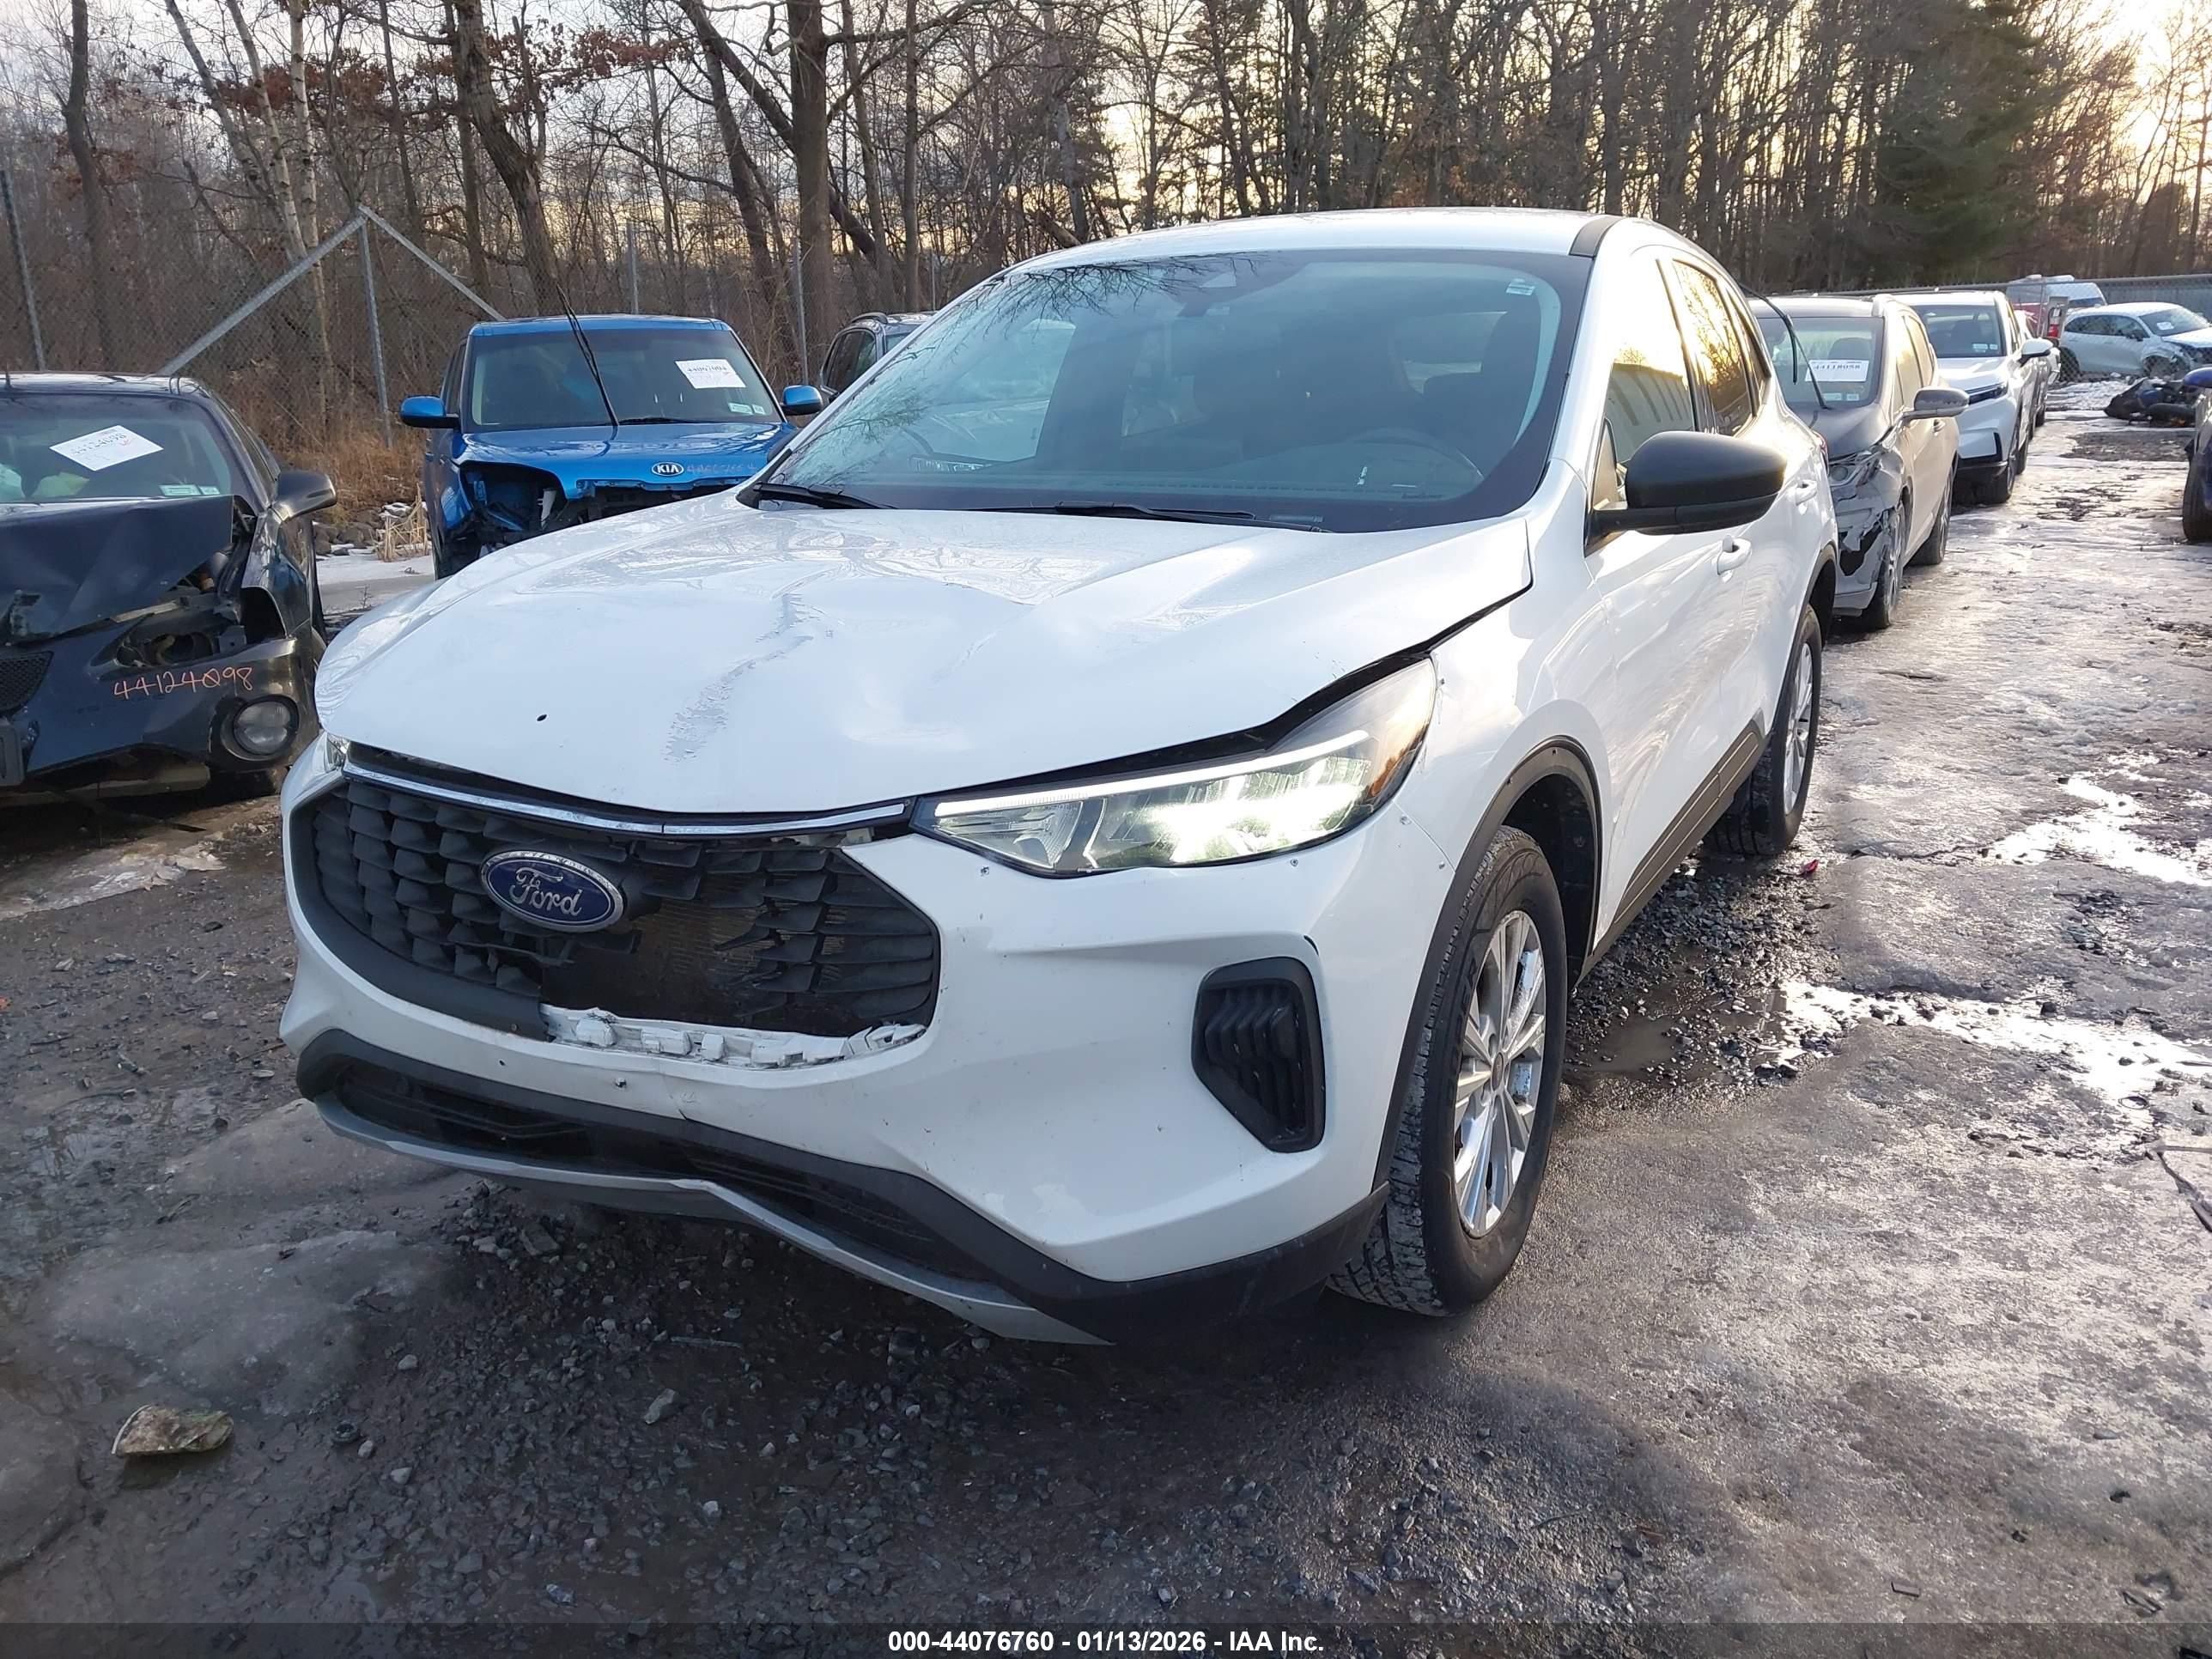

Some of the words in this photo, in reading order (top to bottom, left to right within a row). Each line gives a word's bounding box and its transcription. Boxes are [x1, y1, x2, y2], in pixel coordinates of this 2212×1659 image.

[656, 464, 679, 473] KIA
[113, 666, 253, 700] 44124098
[508, 866, 582, 916] Ford
